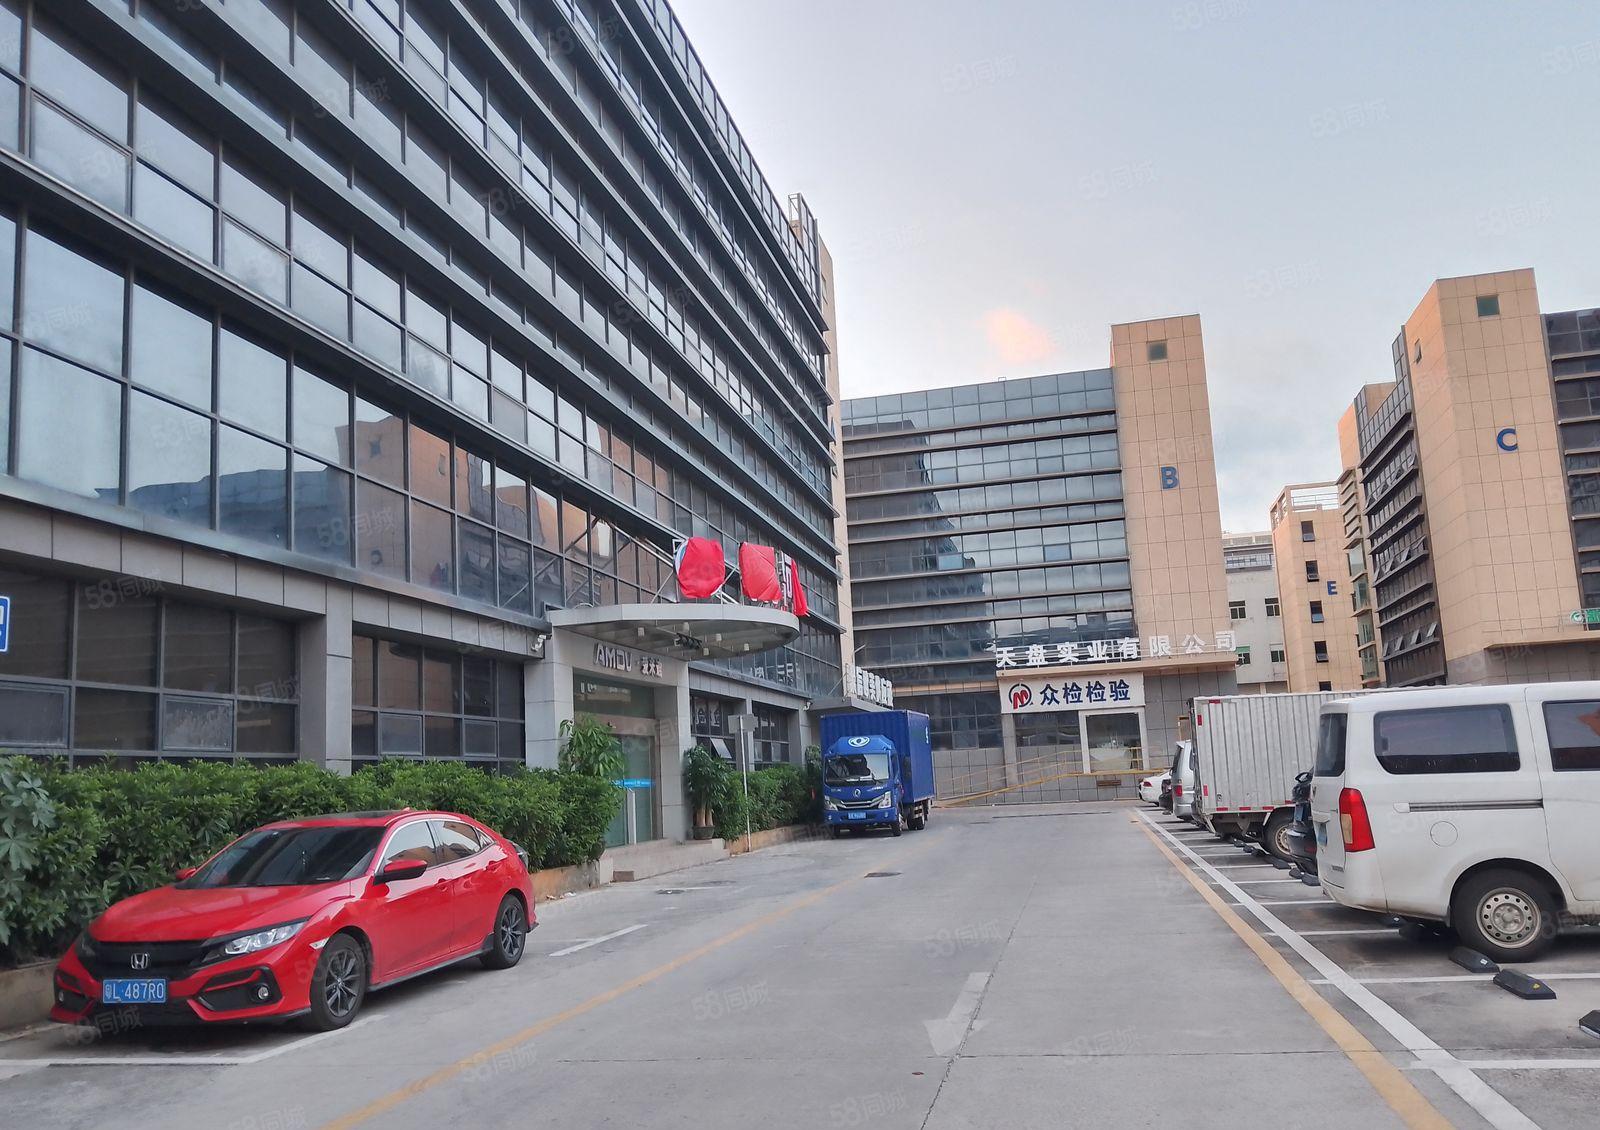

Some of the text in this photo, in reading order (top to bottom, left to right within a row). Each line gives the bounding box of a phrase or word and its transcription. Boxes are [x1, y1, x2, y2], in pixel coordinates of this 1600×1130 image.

[1497, 428, 1519, 452] C
[1161, 466, 1180, 490] B
[1327, 580, 1338, 597] E
[996, 630, 1237, 668] 天盘实业有限公司
[1040, 678, 1131, 707] 众检检验
